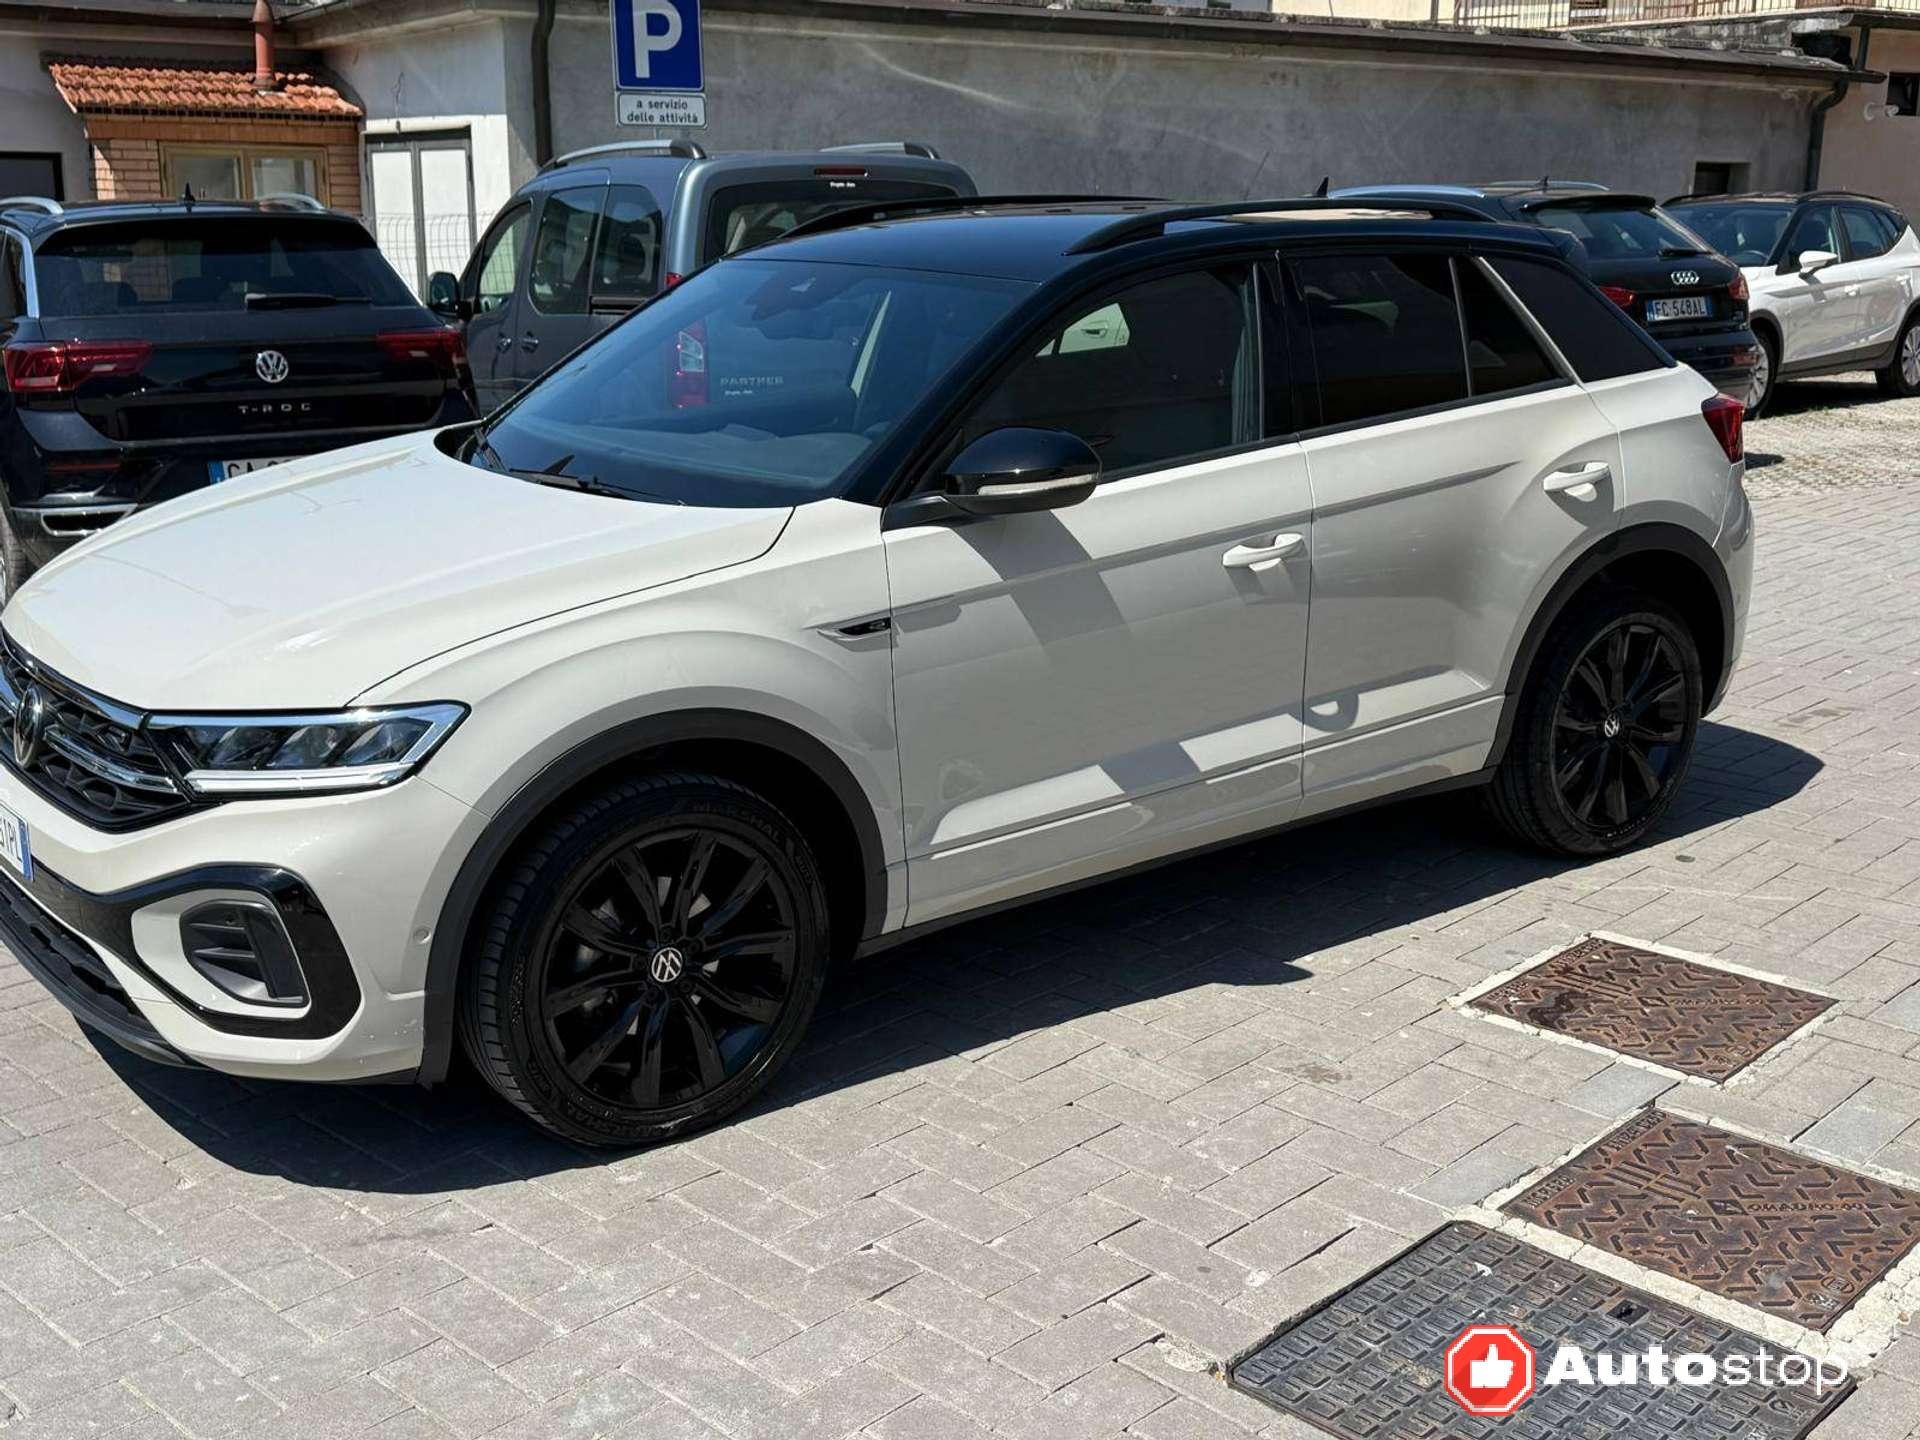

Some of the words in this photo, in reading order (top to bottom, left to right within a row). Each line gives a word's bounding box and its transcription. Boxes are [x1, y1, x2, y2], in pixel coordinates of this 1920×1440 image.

[632, 0, 682, 78] P
[636, 100, 643, 109] a
[648, 98, 688, 110] servizio
[627, 111, 655, 122] delle
[1654, 301, 1669, 317] FC
[1672, 298, 1706, 316] 548AL
[238, 403, 312, 414] T-ROC
